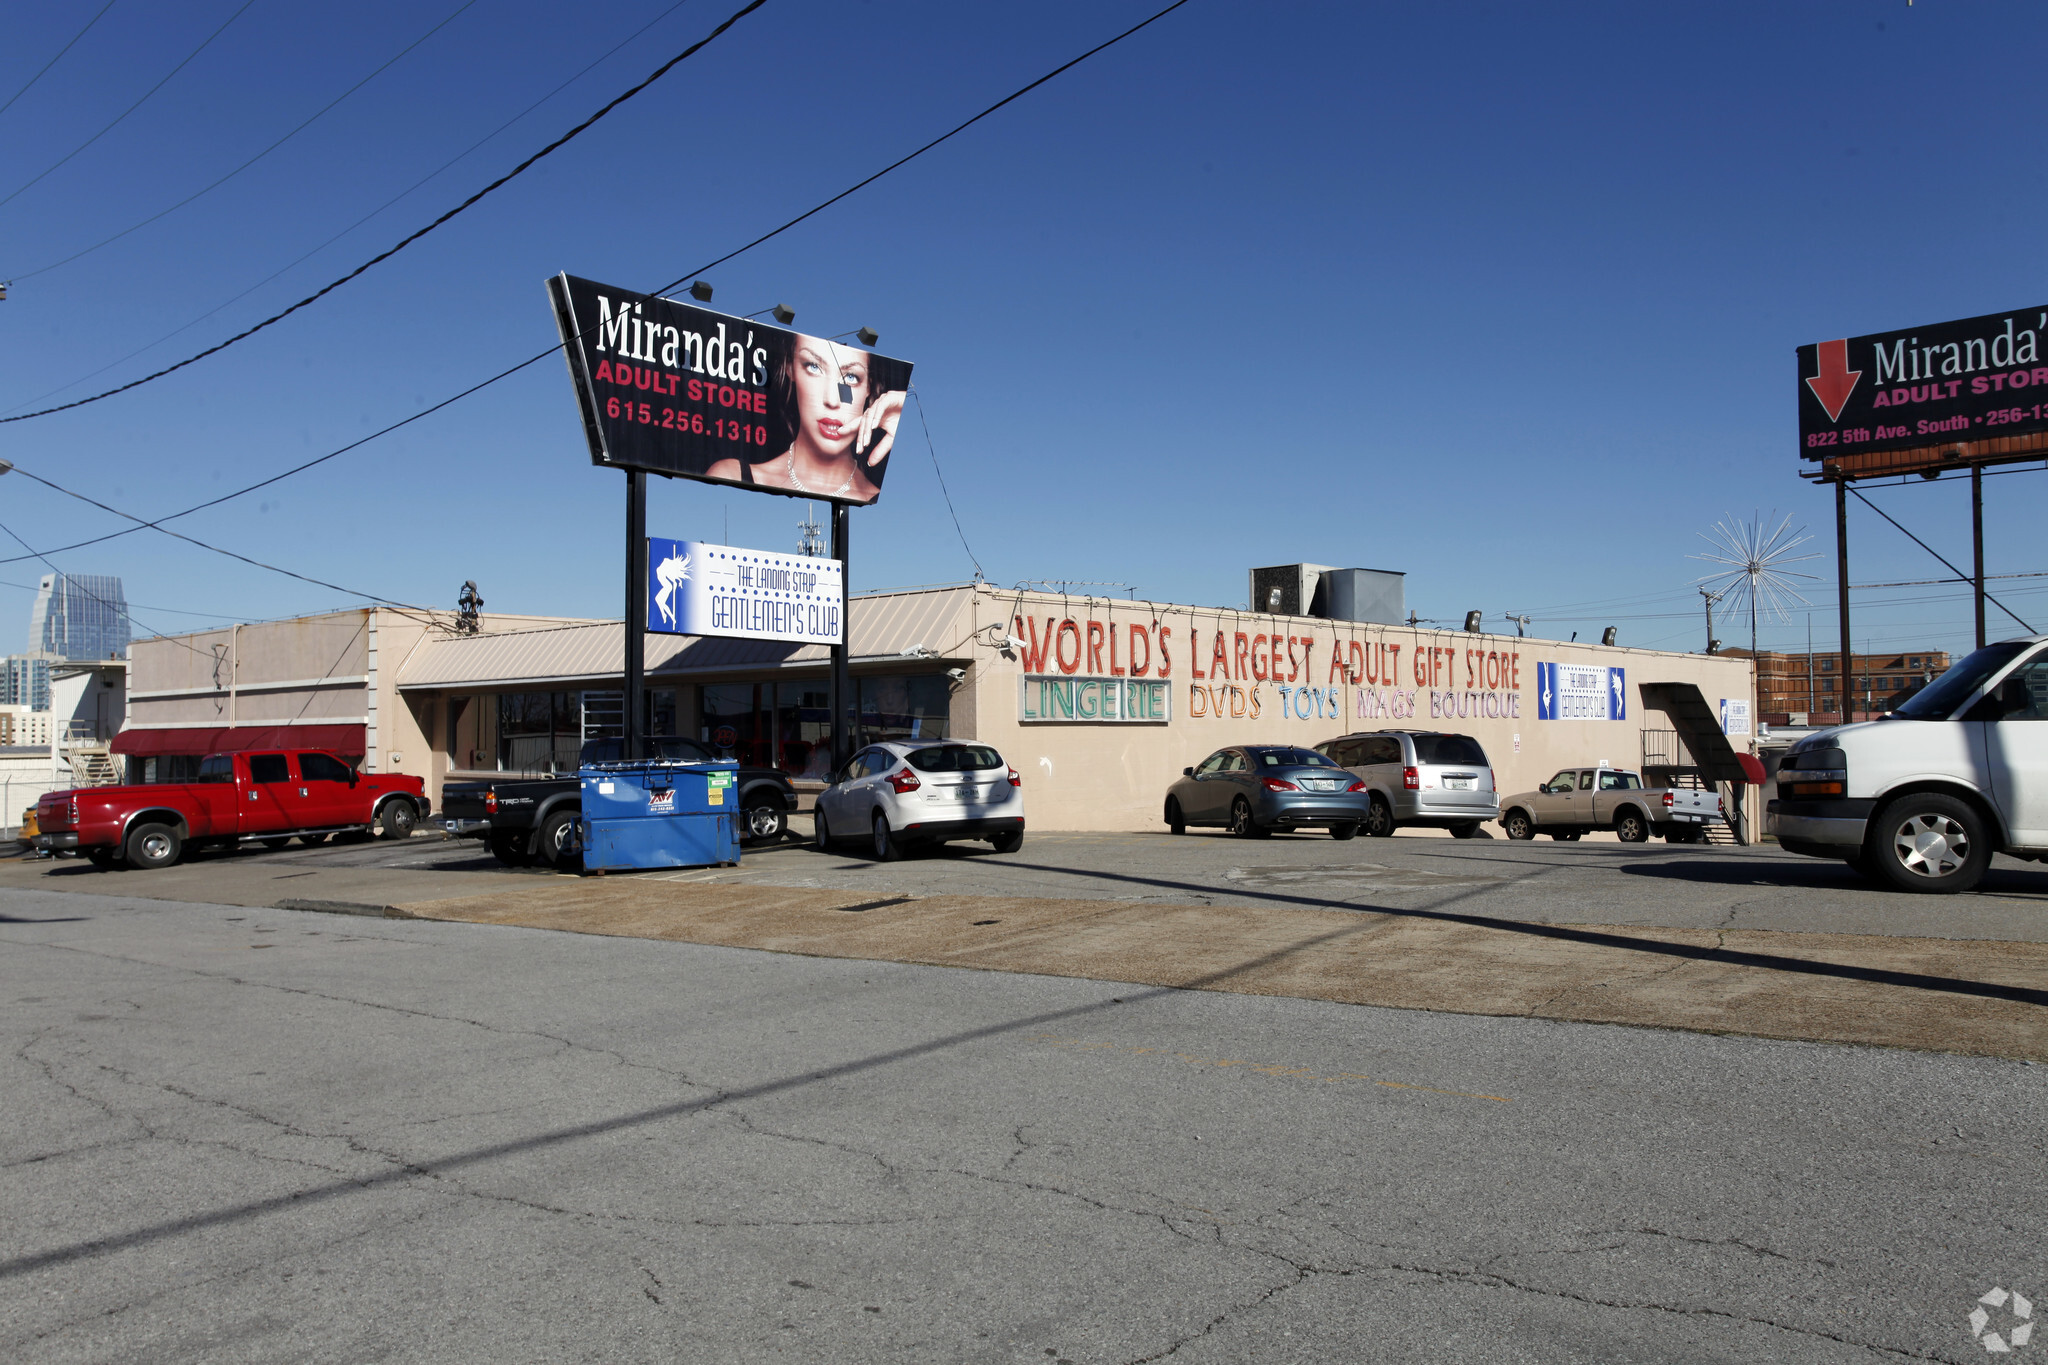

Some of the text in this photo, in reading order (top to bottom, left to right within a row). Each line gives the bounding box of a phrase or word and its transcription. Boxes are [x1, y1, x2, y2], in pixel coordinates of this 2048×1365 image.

[597, 296, 767, 386] Miranda's
[596, 360, 767, 414] ADULT STORE
[1873, 380, 1962, 408] ADULT
[607, 397, 767, 446] 615.256.1310
[1807, 431, 1838, 447] 822
[1843, 428, 1870, 444] 5th
[1875, 425, 1912, 440] Ave.
[1917, 414, 1969, 435] South
[737, 565, 816, 593] THE LANDING STRIP
[712, 595, 838, 636] GENTLEMEN'S CLUB
[1015, 615, 1520, 690] WORLD'S LARGEST ADULT GIFT STORE
[1024, 679, 1520, 720] LINGERIE DVDS TOYS MAGS BOUTIQUE
